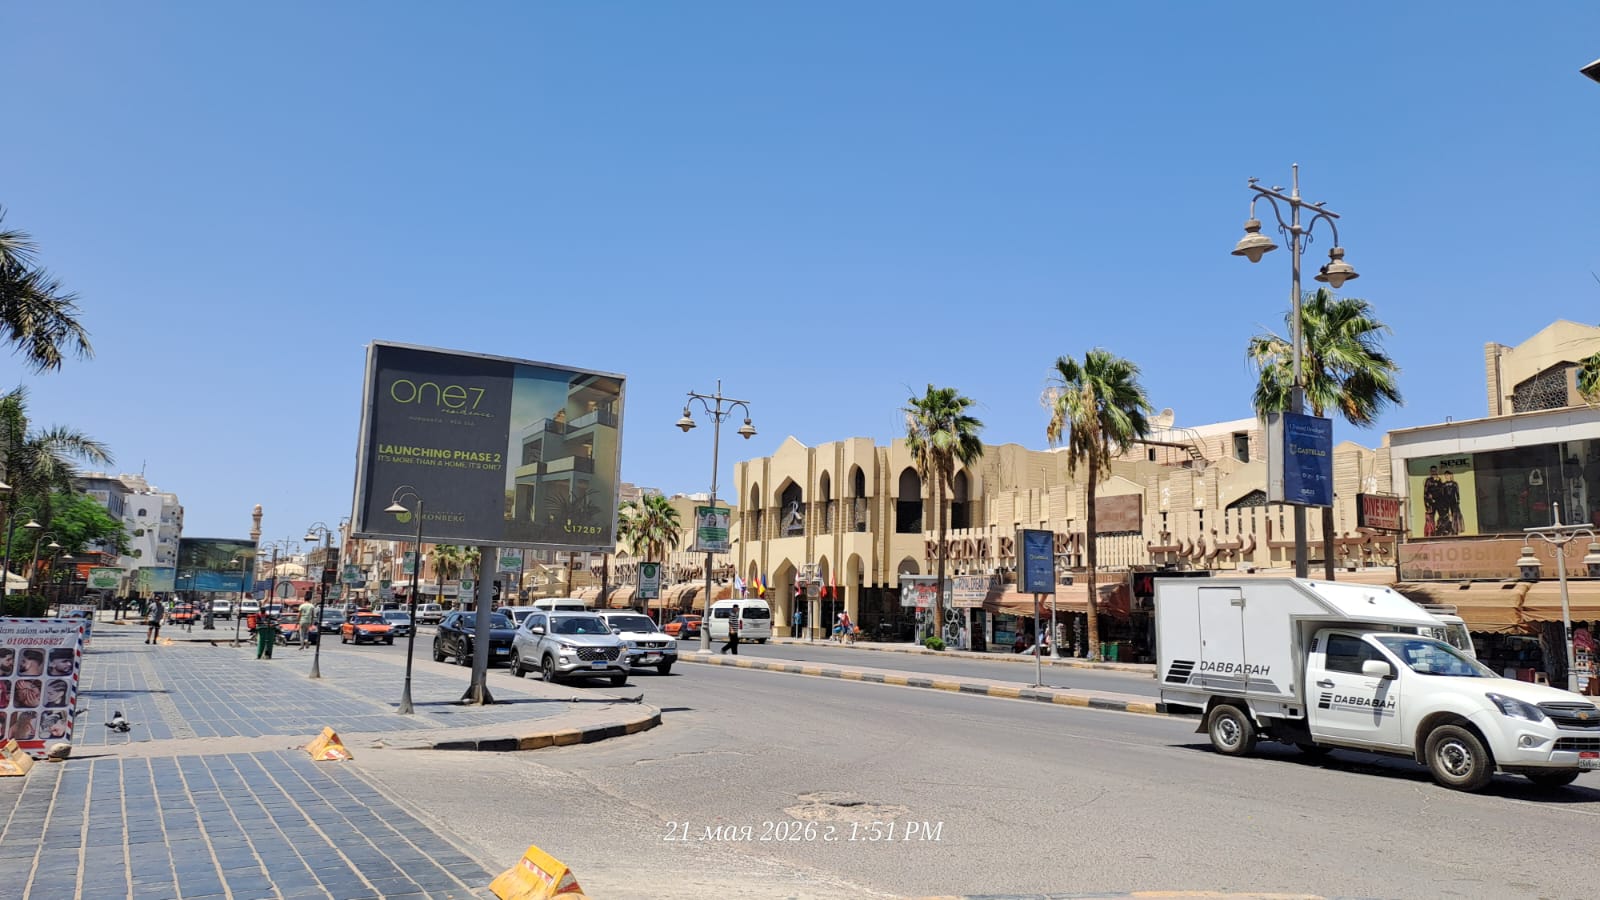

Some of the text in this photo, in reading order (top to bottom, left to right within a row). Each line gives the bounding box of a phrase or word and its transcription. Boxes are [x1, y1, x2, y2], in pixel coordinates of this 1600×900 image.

[391, 379, 485, 409] one7
[379, 444, 501, 462] LAUNCHING PHASE 2
[392, 456, 415, 464] MORE
[416, 457, 436, 466] THAN
[1364, 497, 1399, 519] DIVE SHOP
[572, 525, 602, 534] 17287
[1200, 660, 1271, 676] DABBABAH
[1333, 693, 1396, 709] DABBABAH
